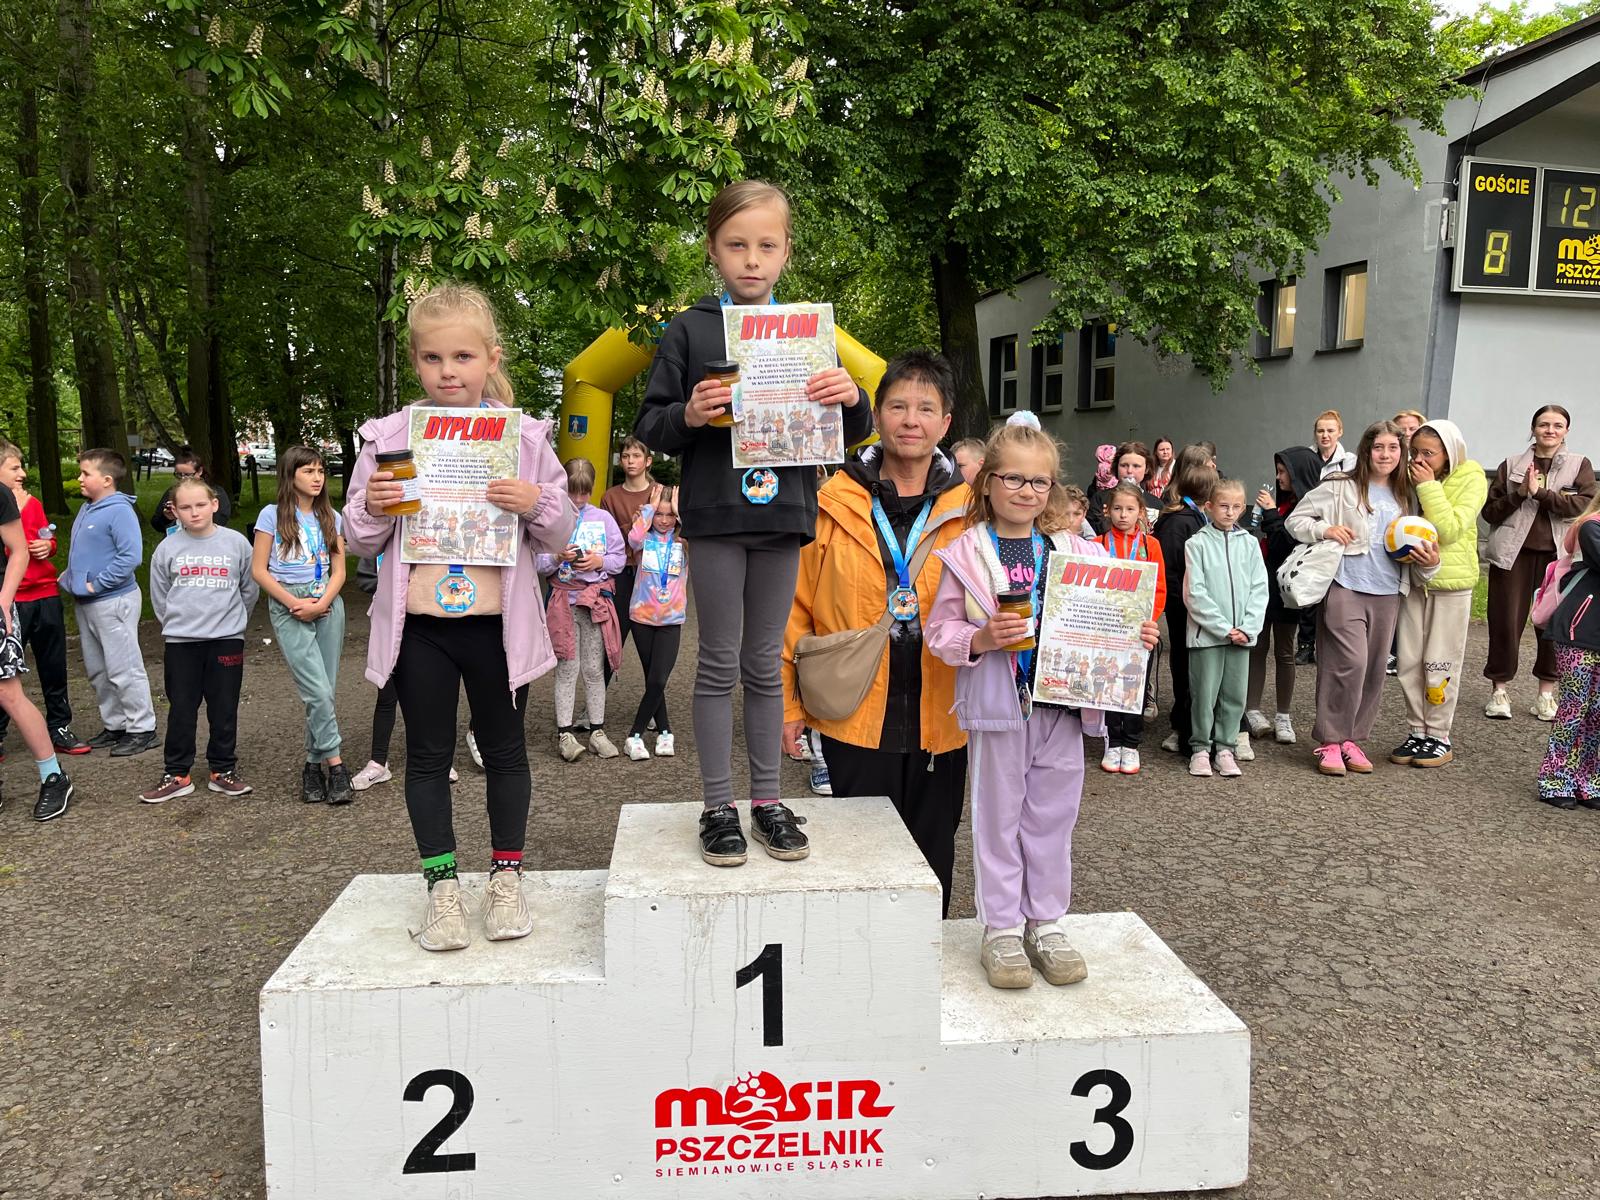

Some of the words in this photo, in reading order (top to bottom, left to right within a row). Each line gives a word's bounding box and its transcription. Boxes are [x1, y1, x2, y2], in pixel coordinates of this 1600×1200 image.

[1474, 174, 1530, 194] GOŚCIE
[1560, 187, 1596, 228] 12
[1484, 232, 1509, 274] 8
[740, 314, 819, 340] DYPLOM
[424, 416, 506, 441] DYPLOM
[176, 554, 231, 566] street
[180, 566, 228, 576] dance
[1060, 562, 1142, 592] DYPLOM
[736, 943, 783, 1047] 1
[402, 1069, 476, 1174] 2
[1070, 1069, 1134, 1170] 3
[656, 1128, 884, 1163] PSZCZELNIK
[656, 1162, 794, 1178] SIEMIANOWICE
